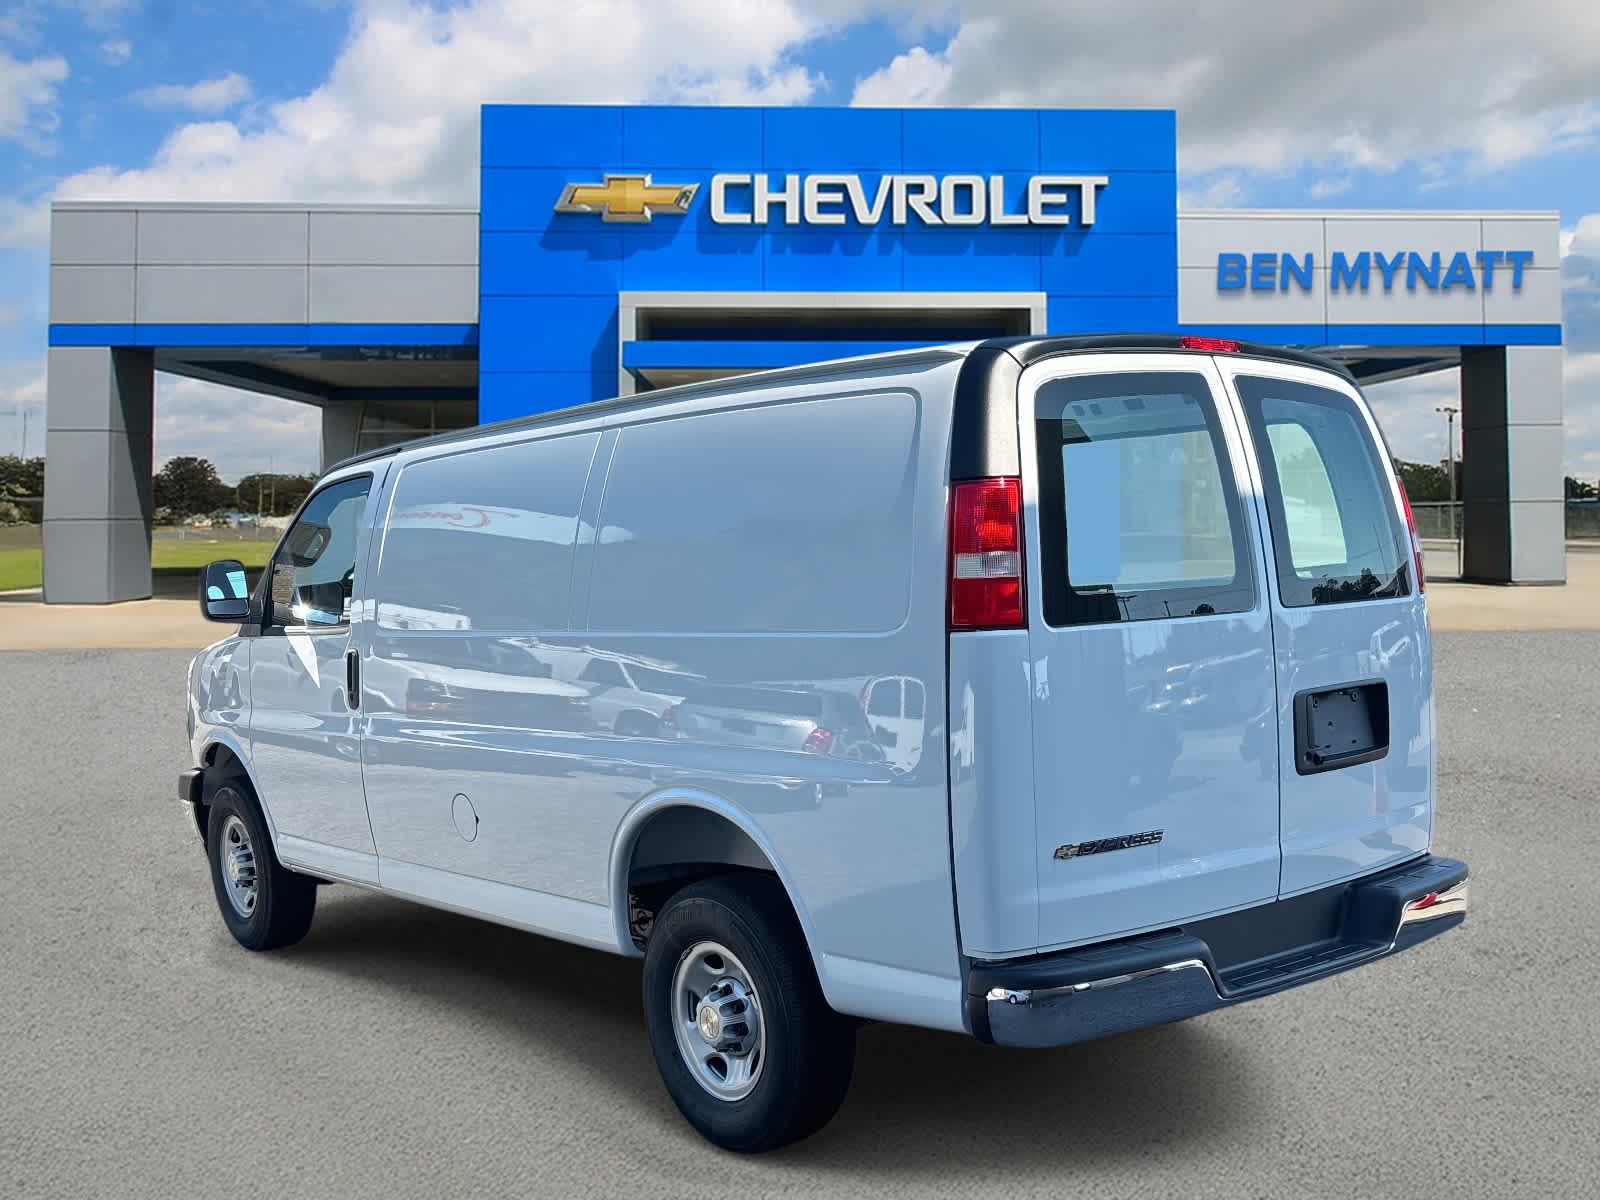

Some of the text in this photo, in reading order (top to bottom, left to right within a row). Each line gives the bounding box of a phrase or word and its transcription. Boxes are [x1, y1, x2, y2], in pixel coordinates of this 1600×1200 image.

[710, 174, 1109, 225] CHEVROLET
[1217, 250, 1534, 291] BEN MYNATT
